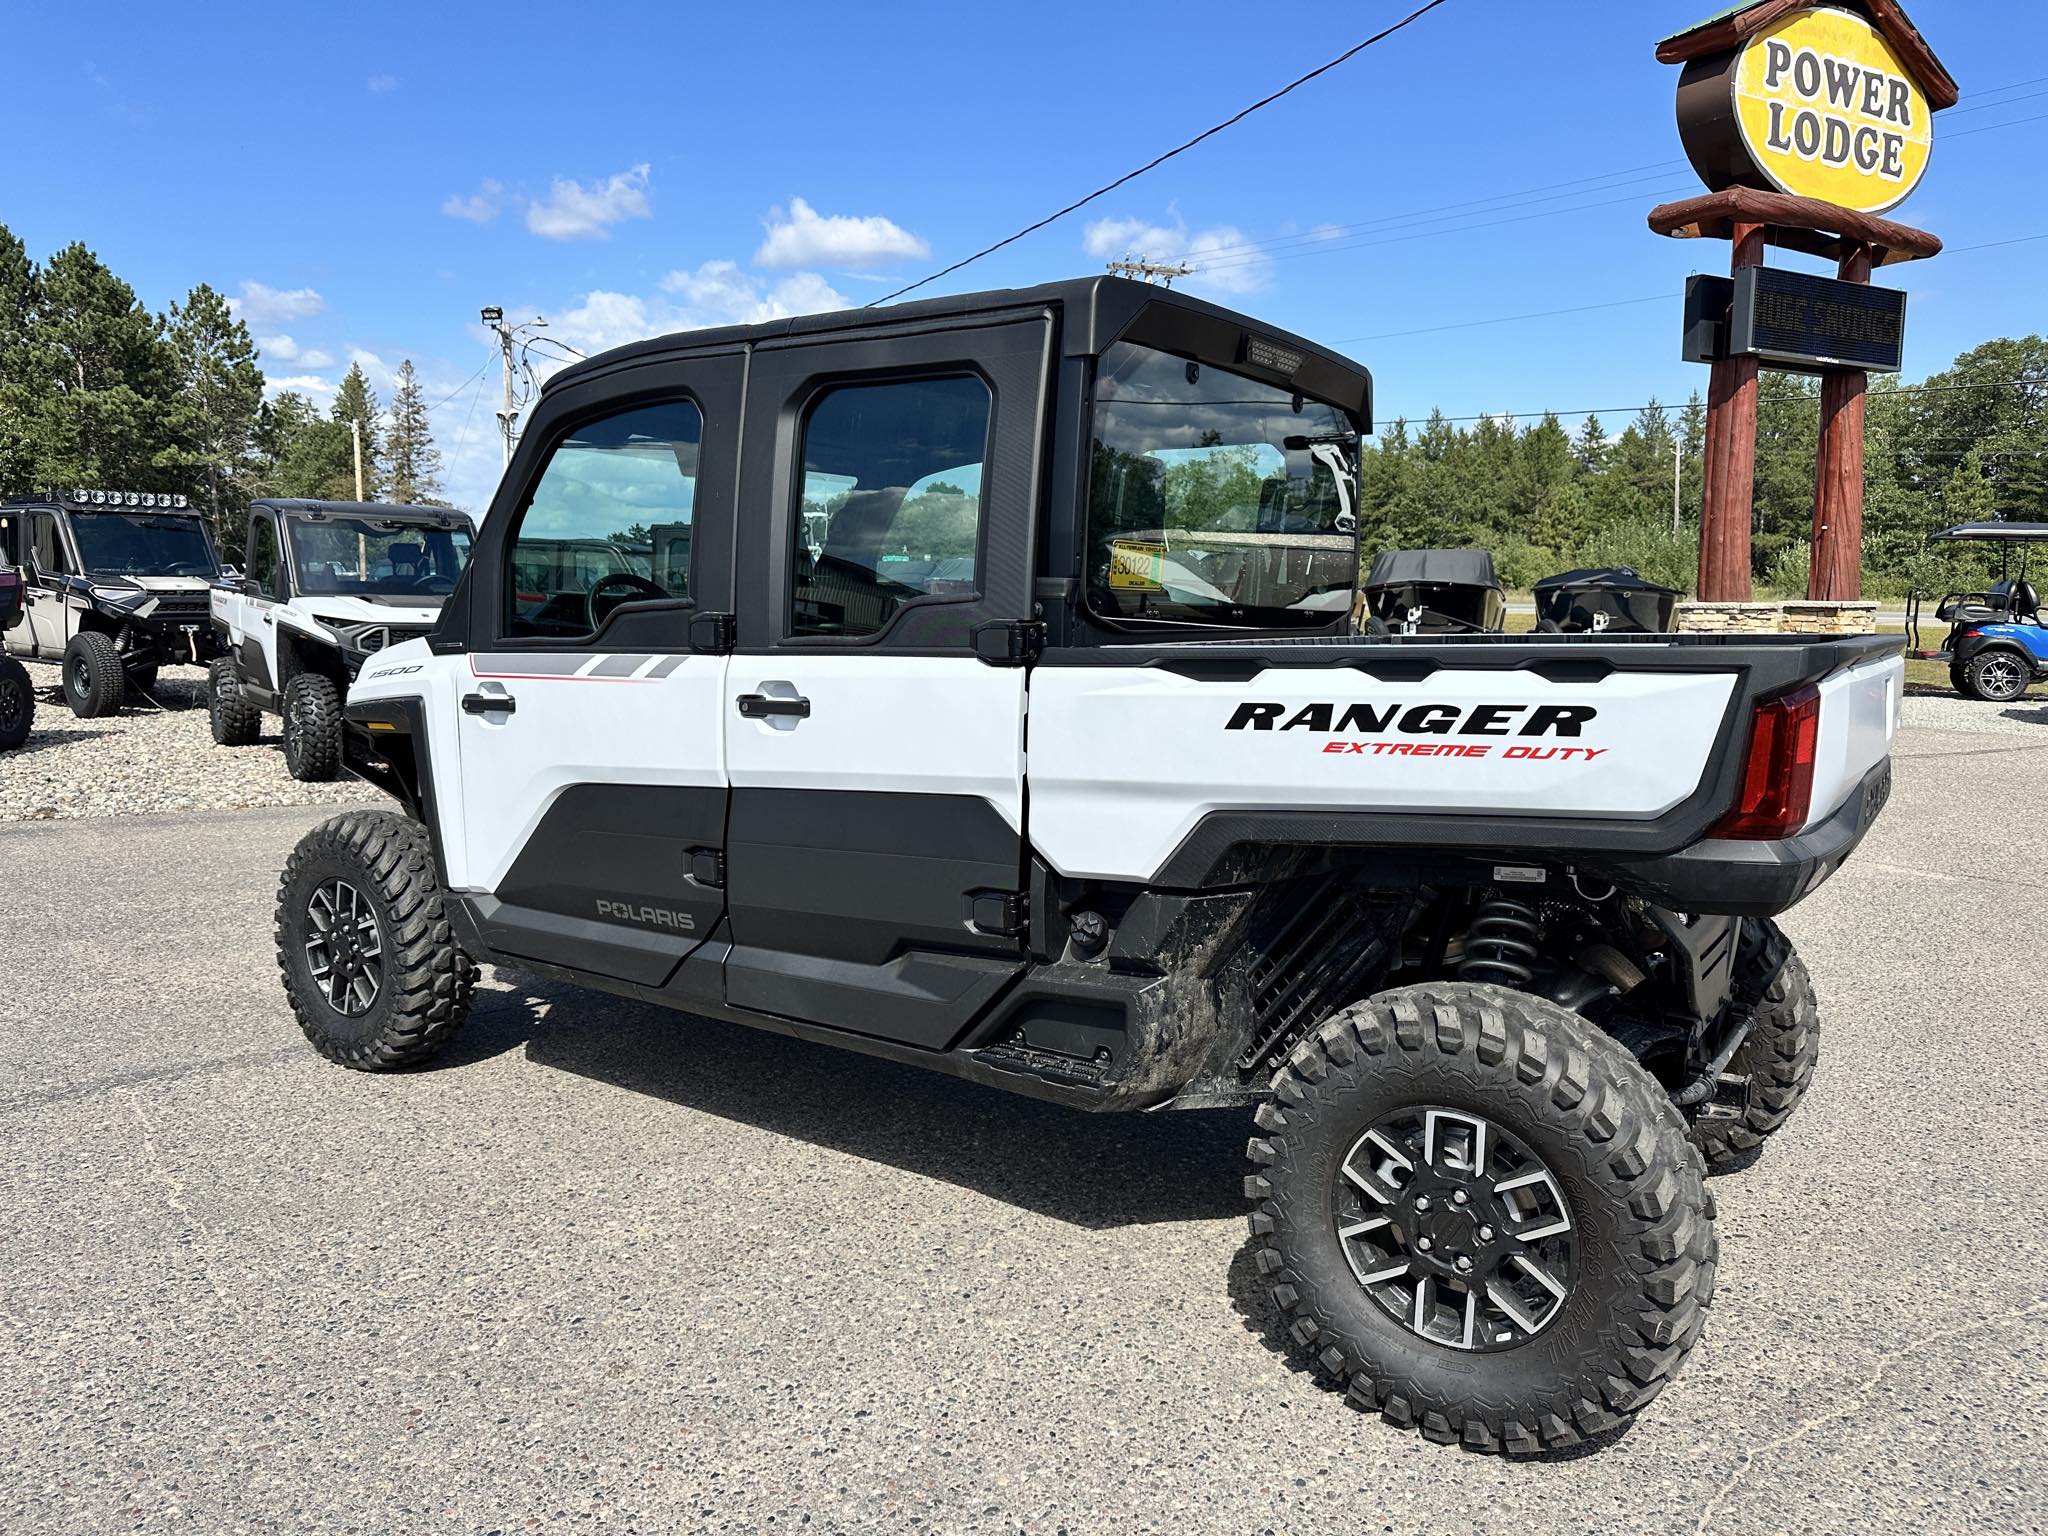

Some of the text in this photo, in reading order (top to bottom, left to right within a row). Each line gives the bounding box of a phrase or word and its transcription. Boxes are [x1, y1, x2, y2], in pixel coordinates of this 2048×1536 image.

[1765, 41, 1911, 126] POWER
[1767, 102, 1905, 178] LODGE
[1117, 555, 1150, 575] 30122
[368, 665, 424, 679] 1500
[1224, 702, 1598, 737] RANGER
[1322, 741, 1609, 761] EXTREME DUTY
[596, 899, 695, 930] POLARIS
[1548, 1174, 1605, 1366] CROSS TRAIL
